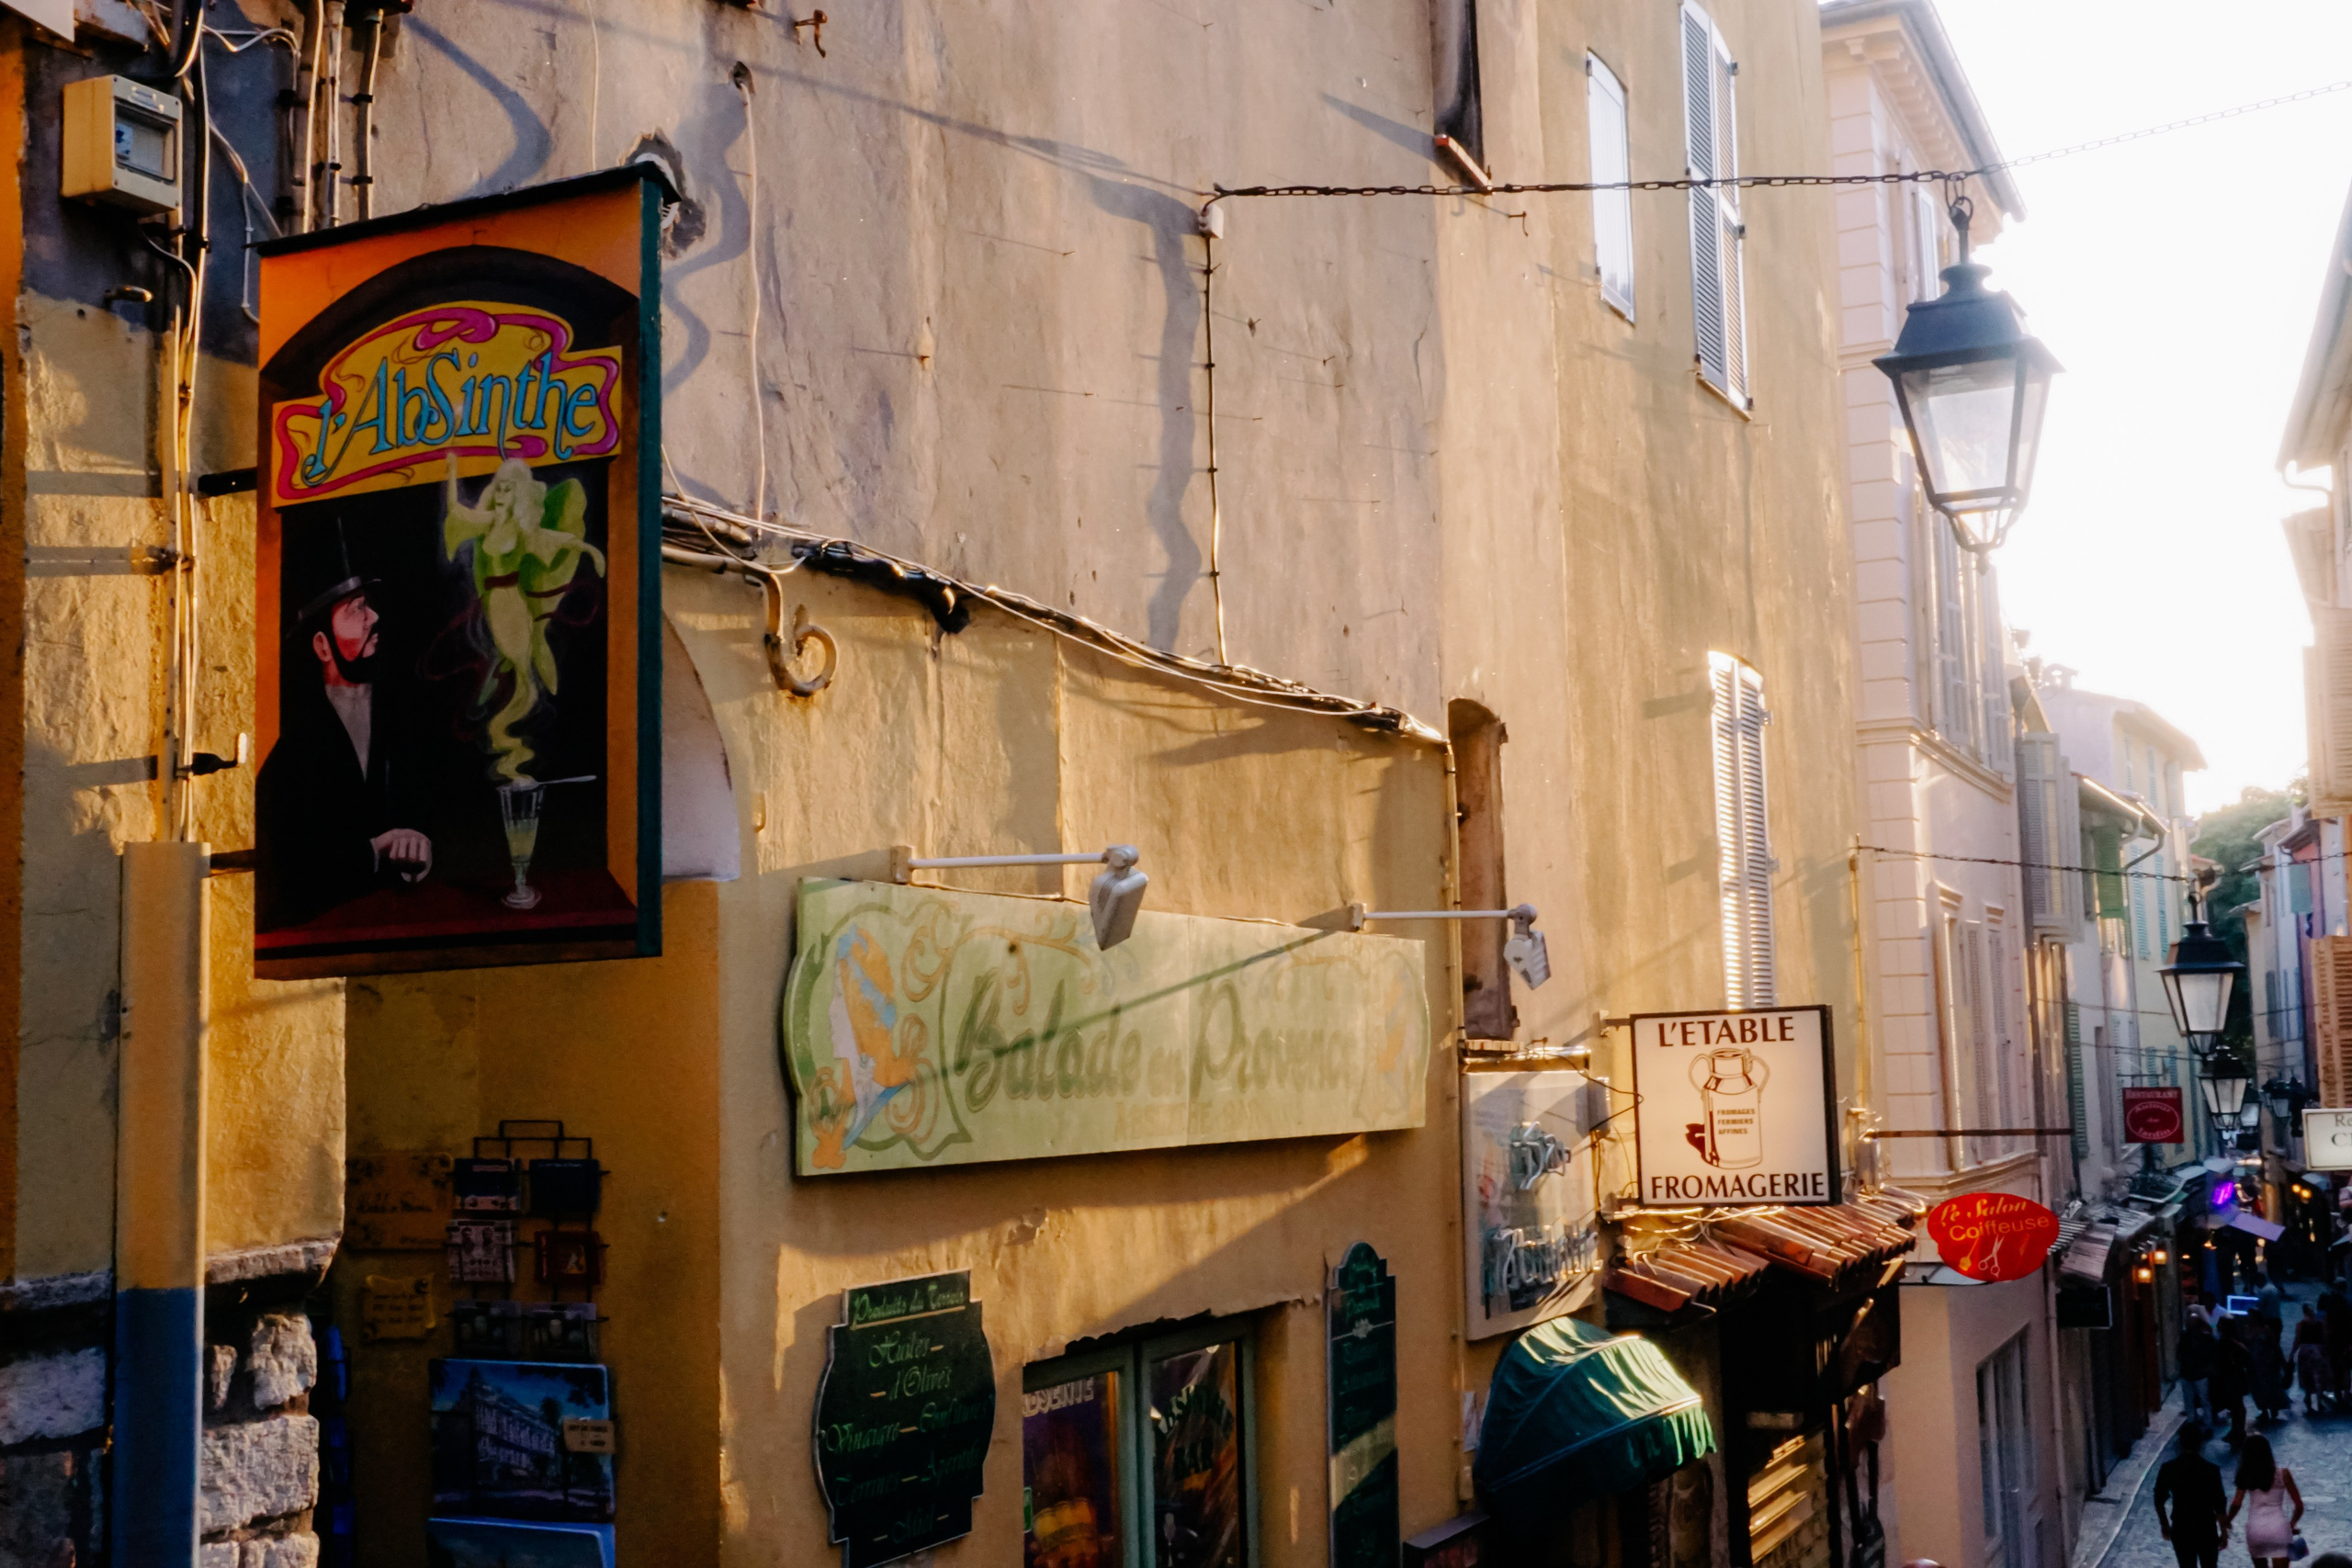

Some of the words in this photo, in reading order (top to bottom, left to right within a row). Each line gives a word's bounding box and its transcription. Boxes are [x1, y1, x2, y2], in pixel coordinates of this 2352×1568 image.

[953, 967, 1143, 1112] Balade
[1146, 1045, 1185, 1097] en
[1657, 1016, 1795, 1047] L'ETABLE
[1717, 1108, 1756, 1116] FROMAGES
[1651, 1173, 1825, 1200] FROMAGERIE
[1967, 1197, 2028, 1218] Salon
[1950, 1216, 2050, 1241] Coiffeuse
